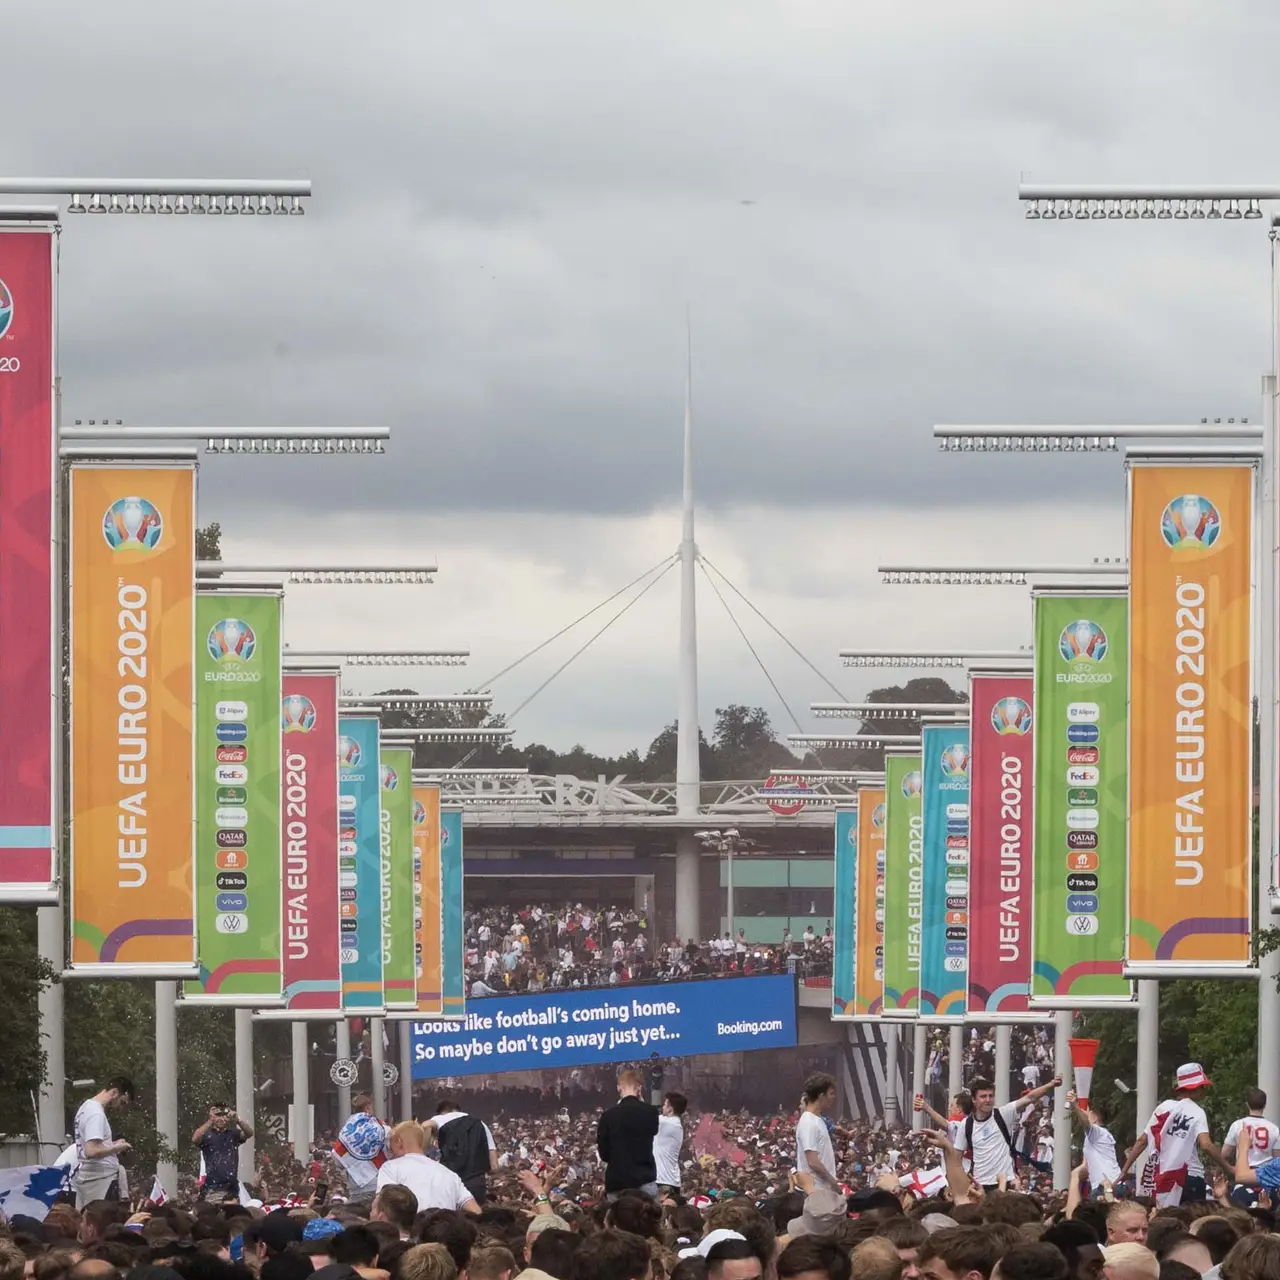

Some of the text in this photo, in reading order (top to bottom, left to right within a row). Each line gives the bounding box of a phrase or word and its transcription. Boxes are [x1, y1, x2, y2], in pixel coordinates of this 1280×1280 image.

[118, 585, 148, 888] UEFA EURO 2020
[1175, 582, 1205, 886] UEFA EURO 2020
[220, 771, 243, 779] FedEx
[1070, 772, 1096, 780] FedEx
[219, 833, 244, 841] QATAR
[1070, 834, 1095, 842] QATAR
[286, 753, 308, 959] UEFA EURO 2020
[999, 756, 1022, 962] UEFA EURO 2020
[464, 1013, 493, 1031] like
[572, 1002, 629, 1023] coming
[632, 999, 681, 1017] home.
[717, 1019, 783, 1037] Booking.com
[415, 1042, 435, 1060] So
[439, 1038, 493, 1061] maybe
[541, 1037, 562, 1055] go
[566, 1032, 606, 1051] away
[609, 1026, 638, 1049] just
